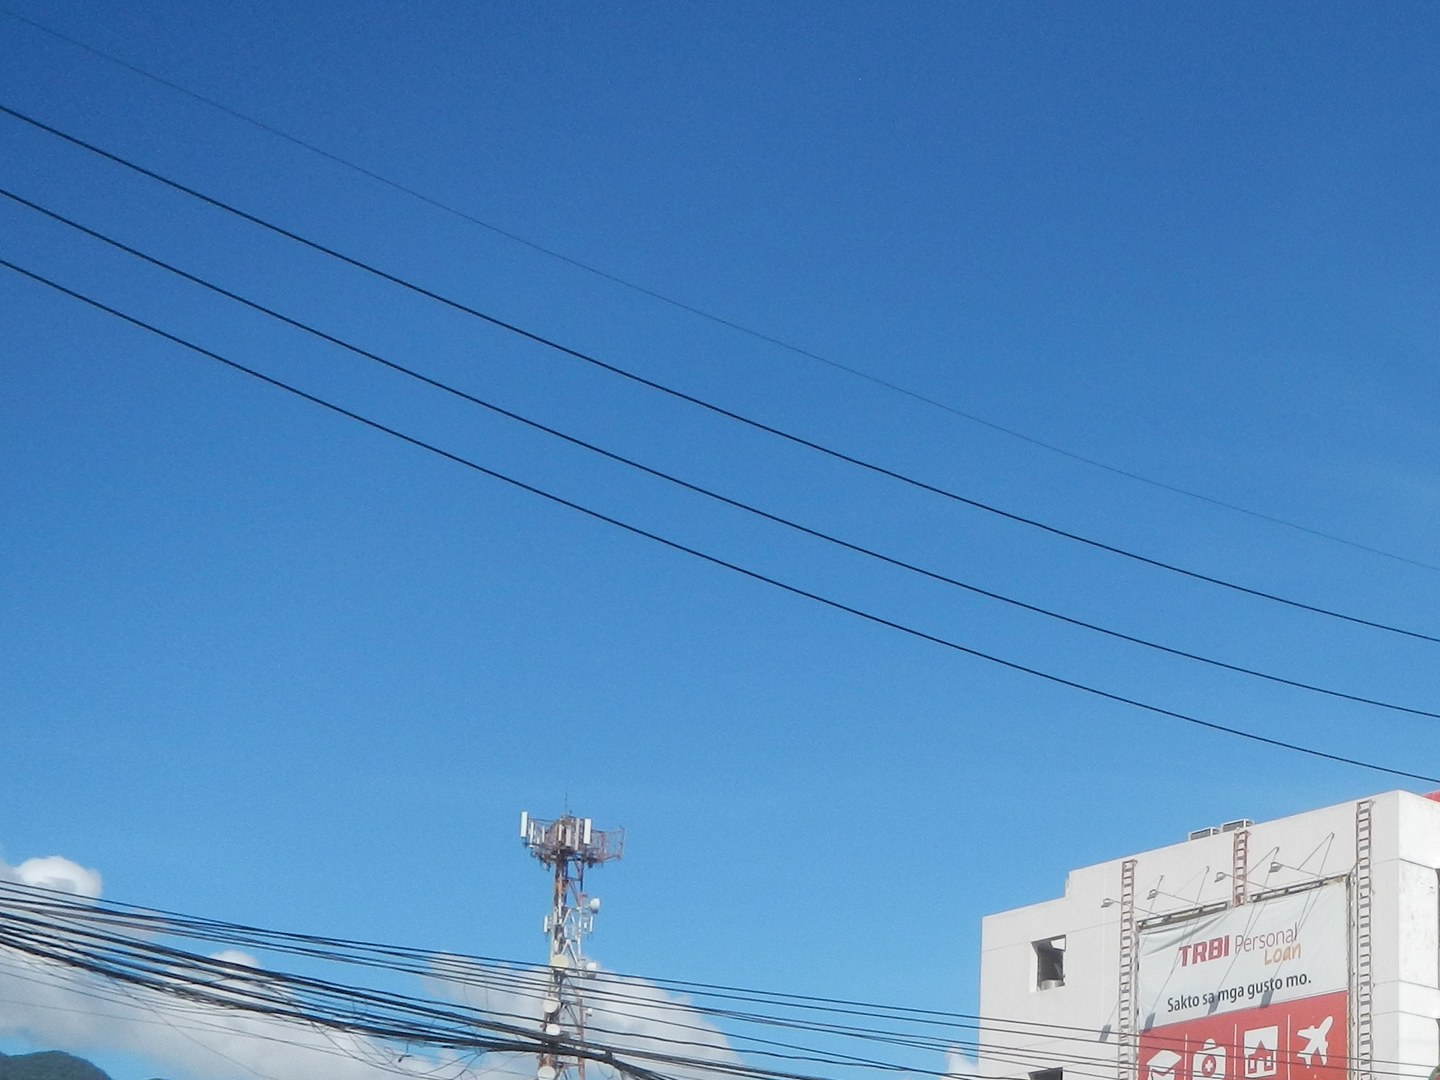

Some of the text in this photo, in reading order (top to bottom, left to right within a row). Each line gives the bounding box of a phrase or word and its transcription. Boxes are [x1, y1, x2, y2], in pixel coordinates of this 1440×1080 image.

[1178, 922, 1298, 968] TRBI Personal
[1264, 943, 1302, 965] Loan
[1167, 973, 1312, 1013] Sakto sa mga gusto mo.
